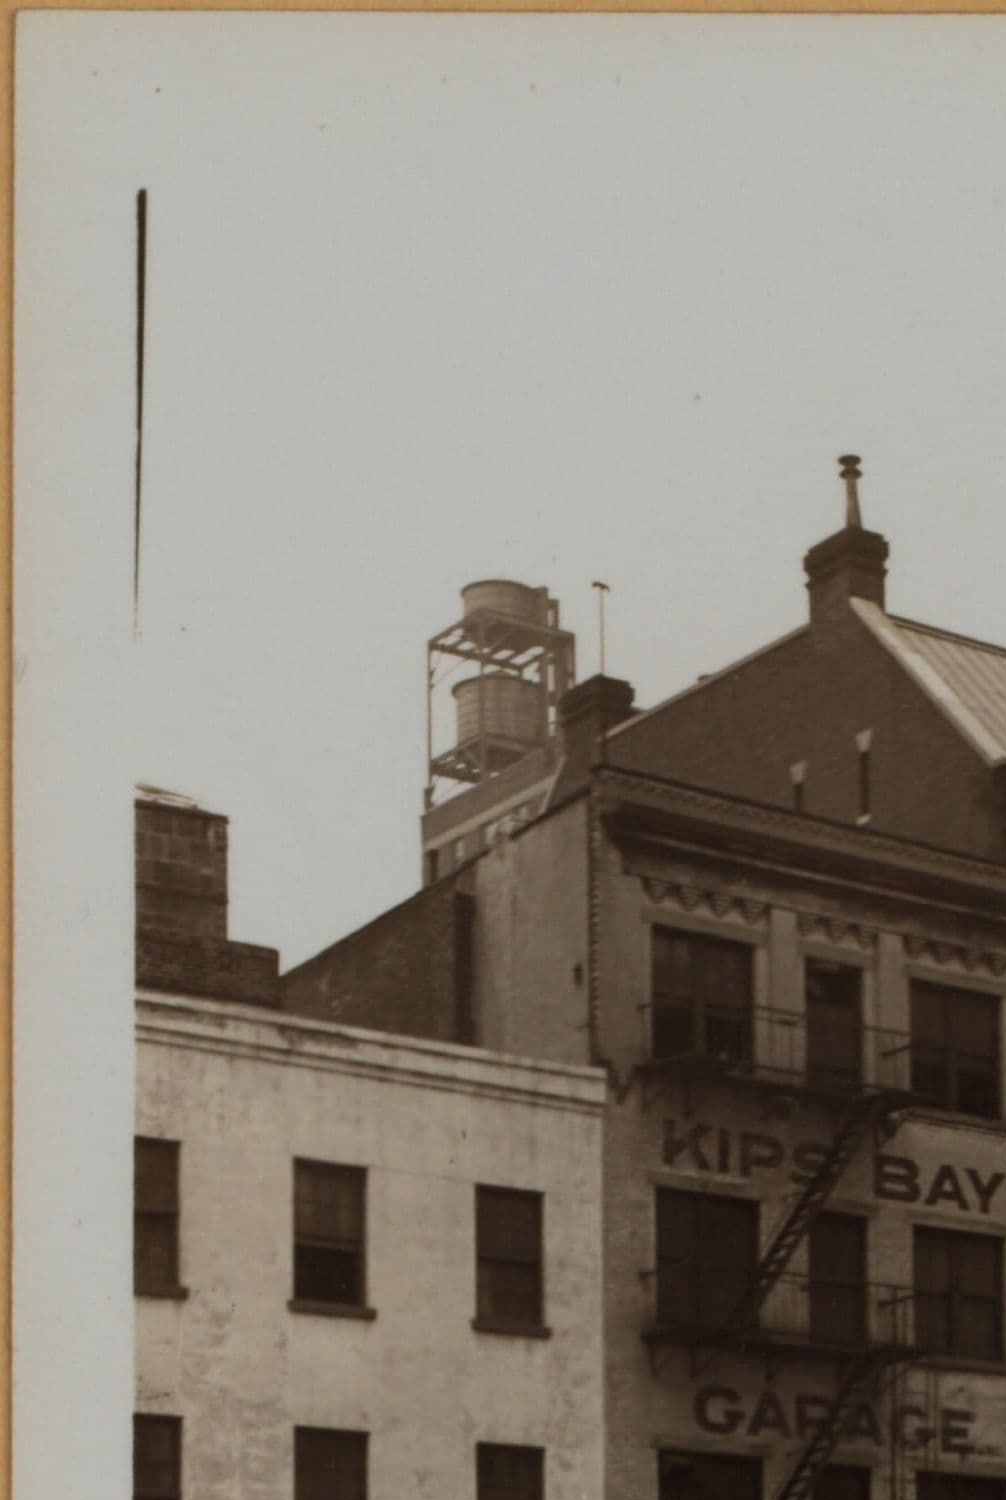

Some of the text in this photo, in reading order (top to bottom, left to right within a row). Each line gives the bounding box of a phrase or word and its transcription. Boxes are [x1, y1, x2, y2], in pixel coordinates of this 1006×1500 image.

[662, 1118, 1005, 1214] KIPS BAY
[692, 1385, 977, 1455] GARAGE
